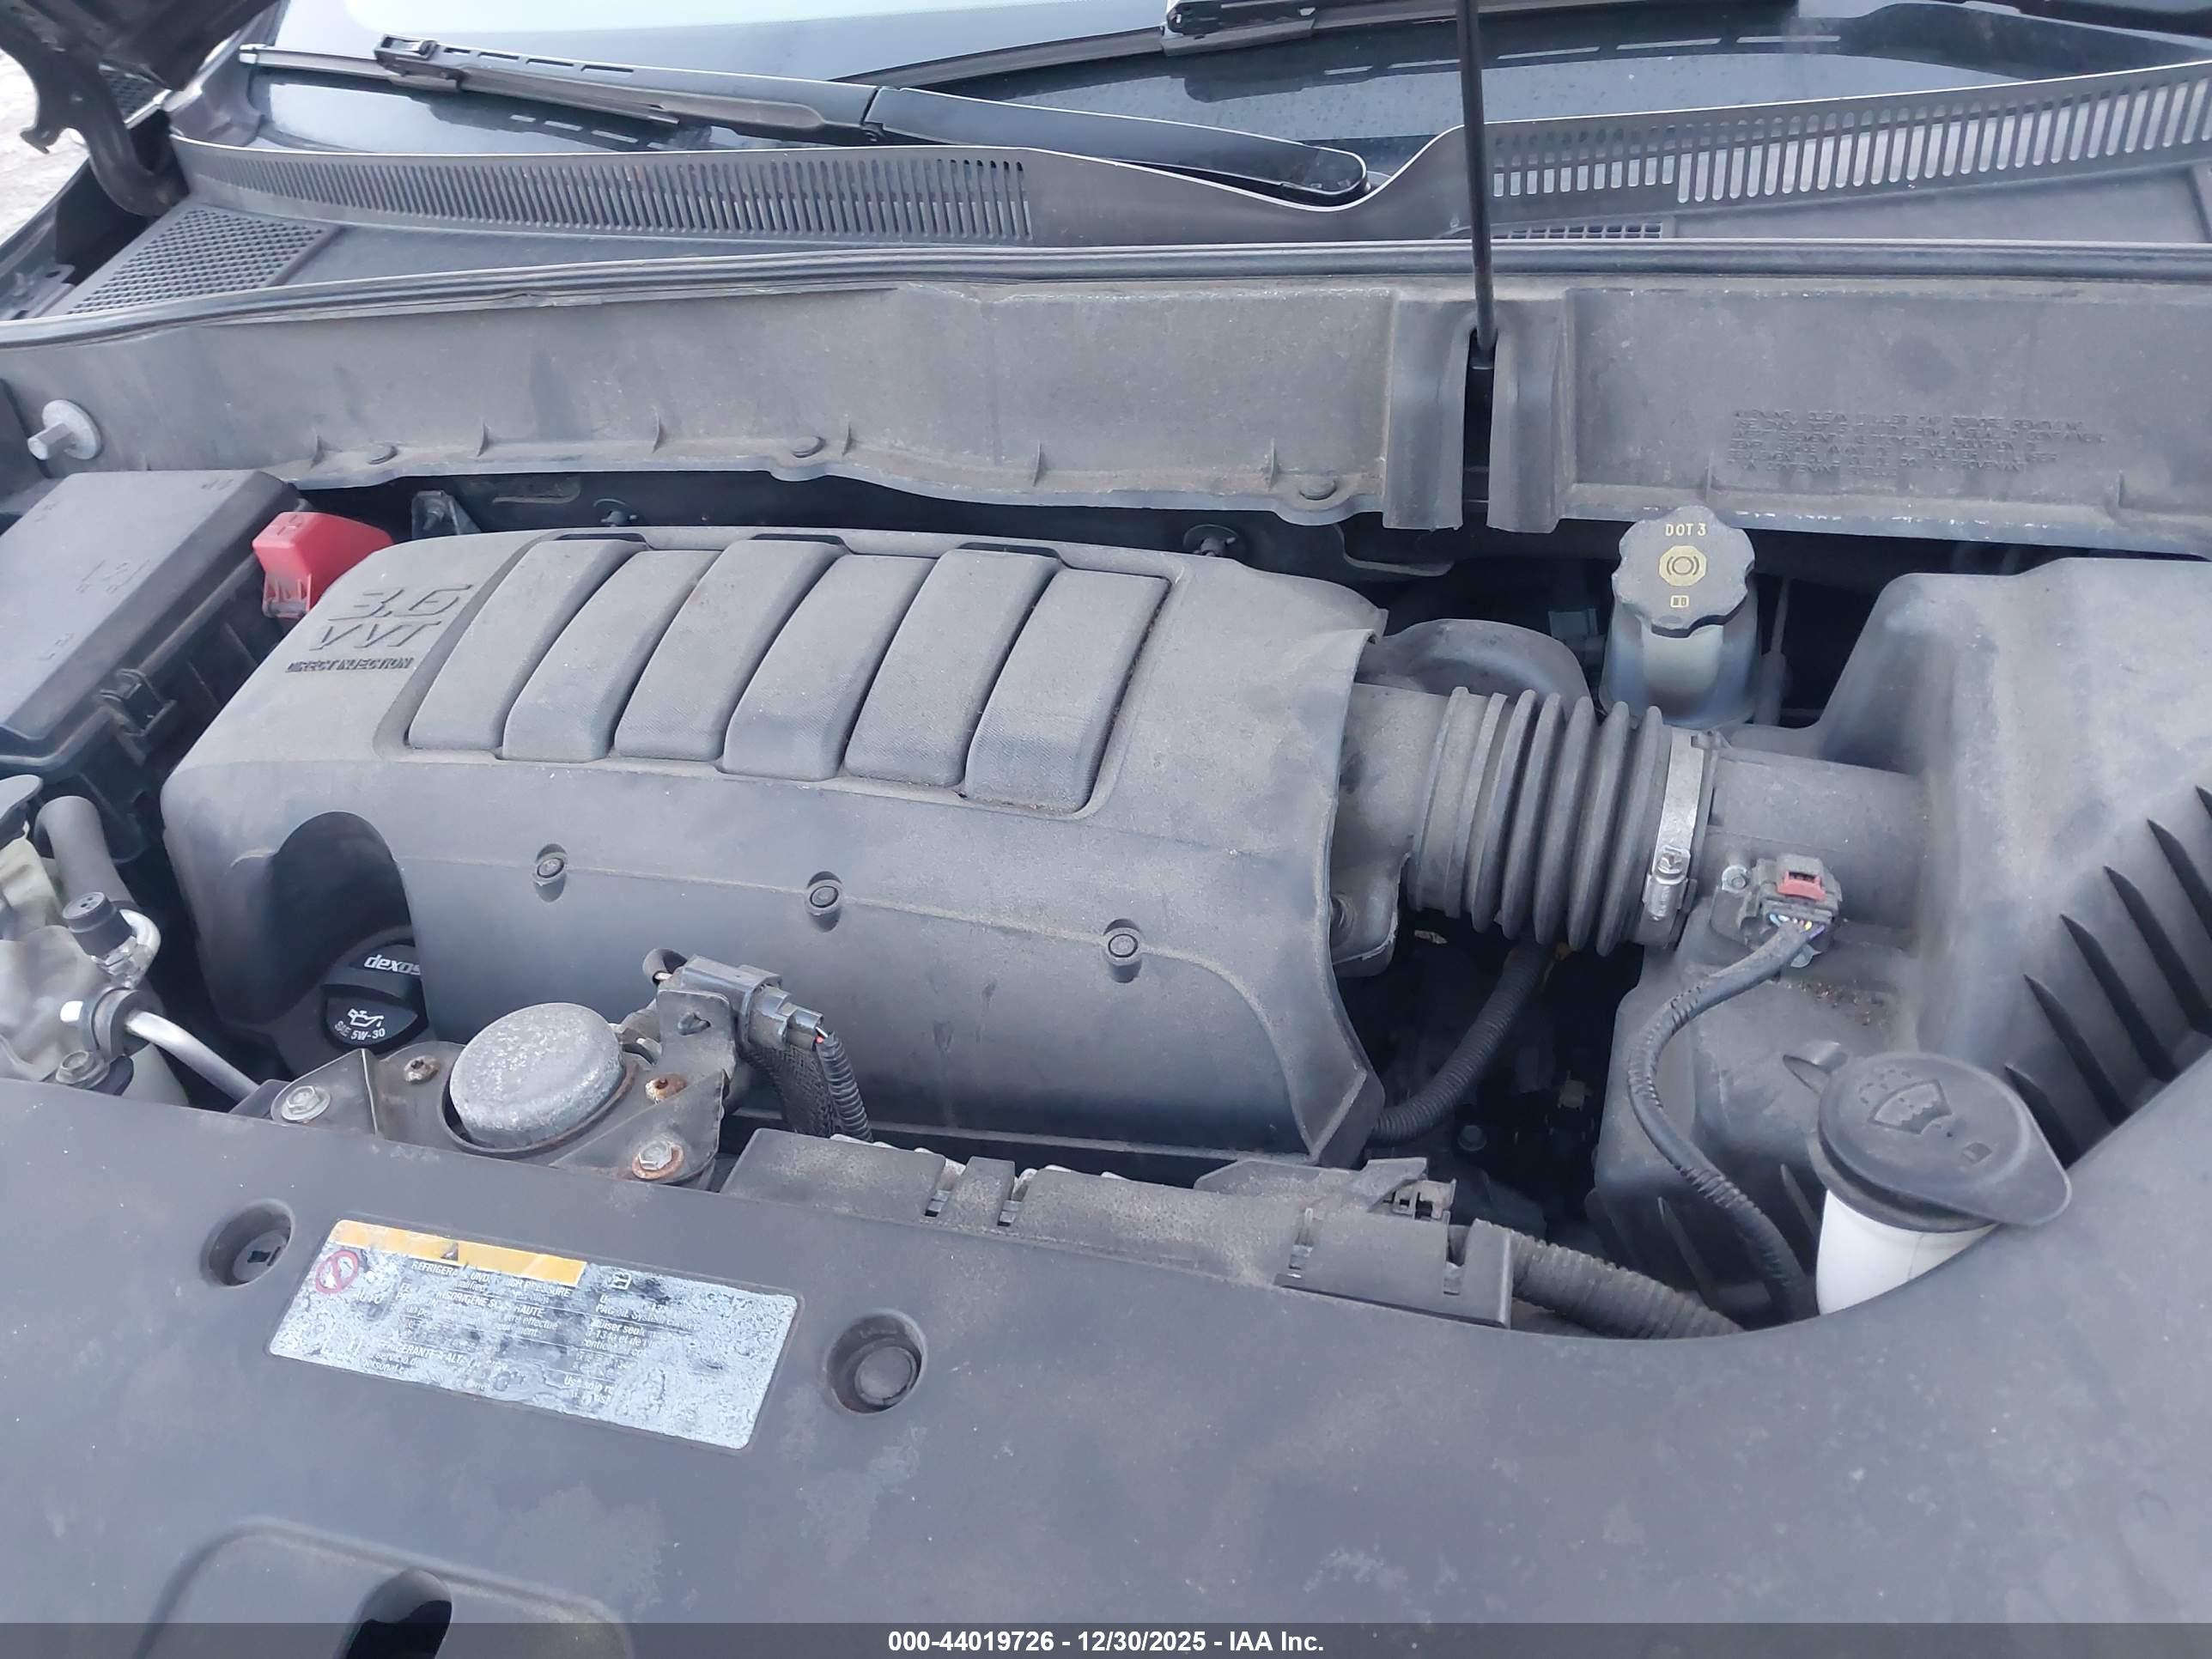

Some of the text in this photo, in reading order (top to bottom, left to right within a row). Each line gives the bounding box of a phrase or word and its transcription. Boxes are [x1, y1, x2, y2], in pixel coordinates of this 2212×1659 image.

[1665, 523, 1707, 536] DOT 3
[328, 584, 473, 621] 3.6
[308, 620, 442, 651] VVT
[285, 656, 415, 673] DIRECT INJECTION
[350, 1028, 386, 1041] 5W-30
